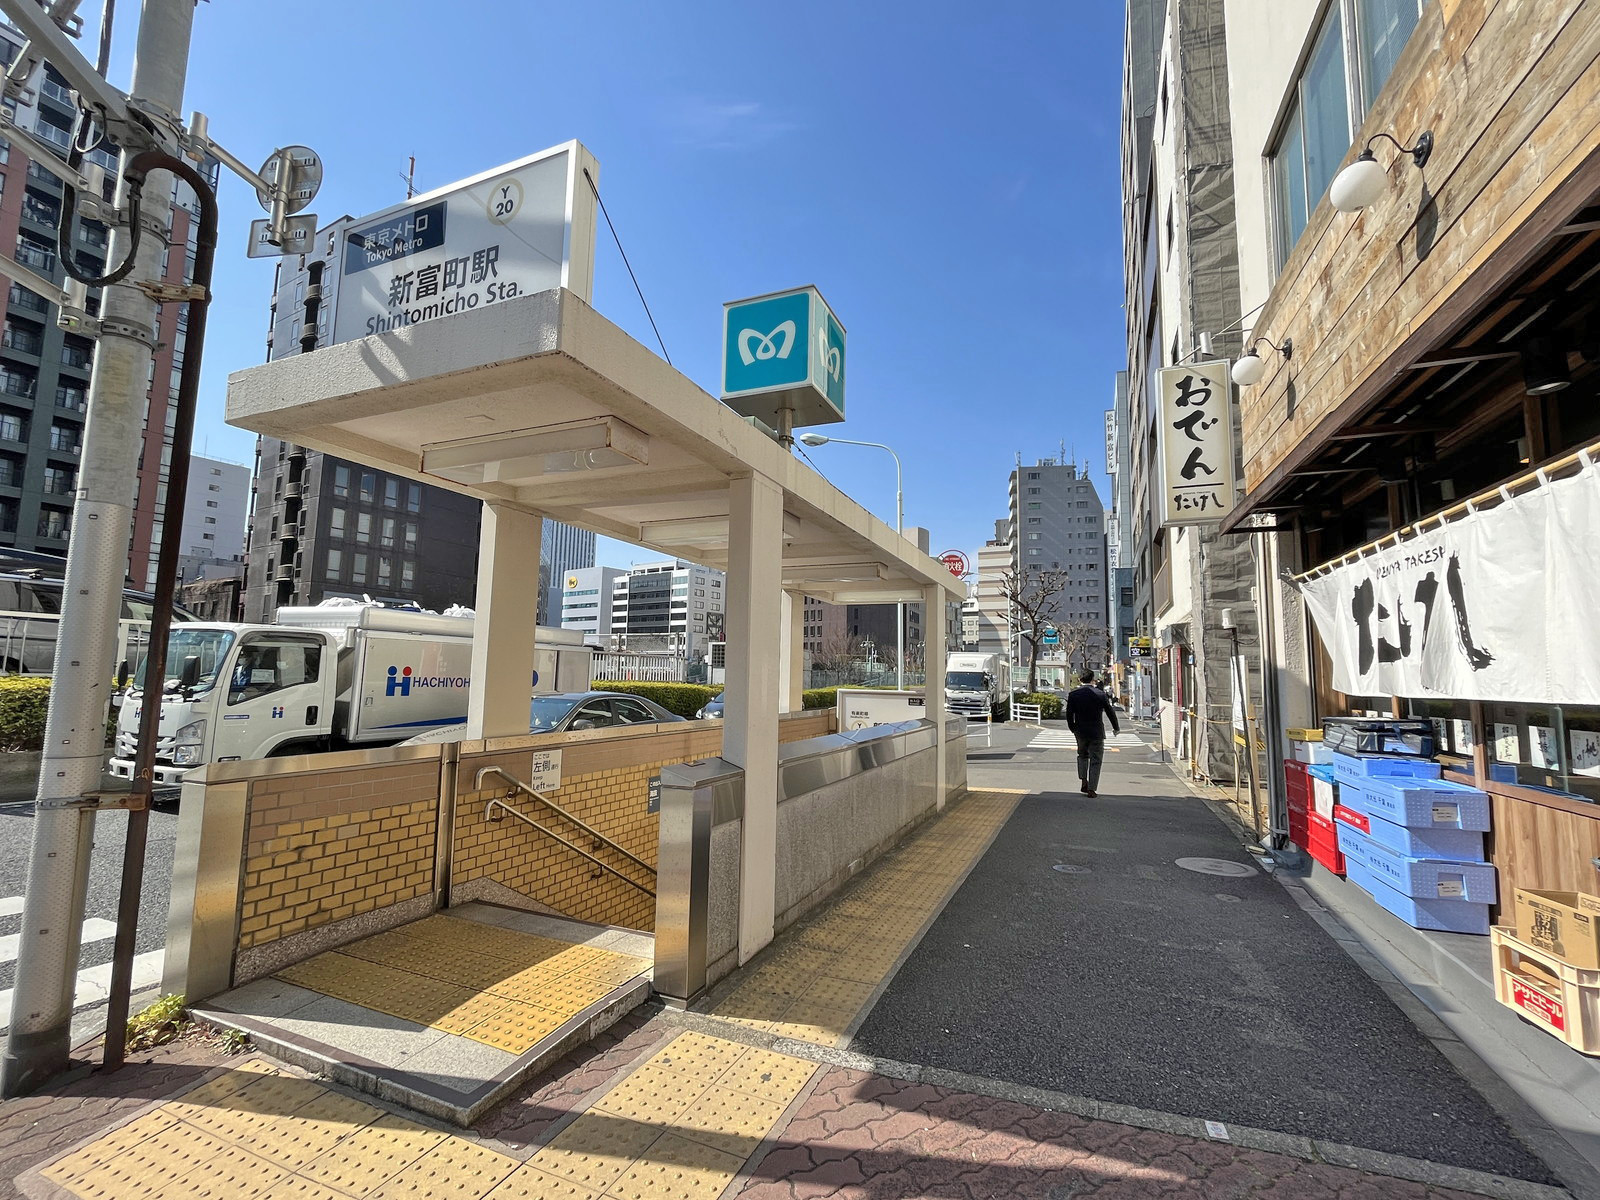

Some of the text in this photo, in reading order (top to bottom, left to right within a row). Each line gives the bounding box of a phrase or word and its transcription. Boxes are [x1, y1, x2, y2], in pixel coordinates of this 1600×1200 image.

[496, 200, 514, 217] 20
[501, 186, 510, 199] Y
[363, 214, 429, 251] 東京メトロ
[366, 236, 423, 264] Tokyo Metro
[388, 245, 500, 307] 新富町駅
[365, 281, 523, 336] Shintomicho Sta.
[1173, 375, 1218, 481] おでん
[1173, 492, 1224, 511] たけし
[1352, 548, 1497, 677] たけし
[533, 781, 546, 790] Left
[1512, 981, 1563, 1018] アサヒビール
